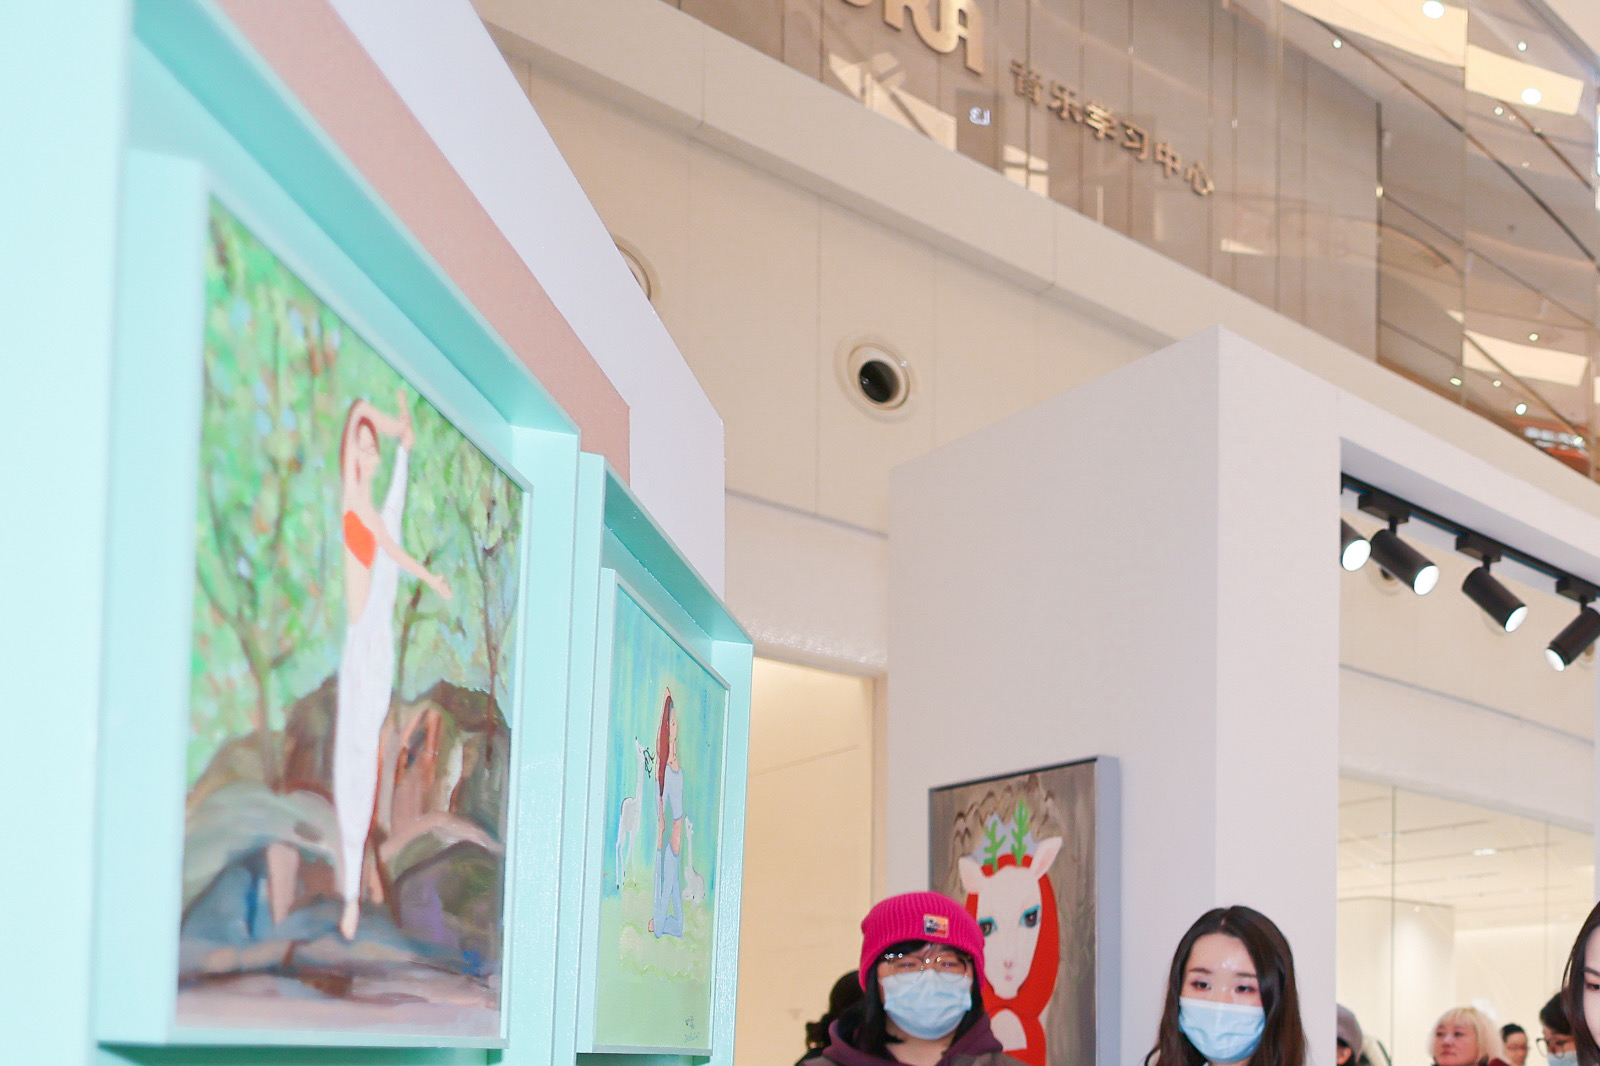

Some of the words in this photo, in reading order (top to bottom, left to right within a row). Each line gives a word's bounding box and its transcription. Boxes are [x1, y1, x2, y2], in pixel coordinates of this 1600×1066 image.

[1009, 58, 1216, 196] 音乐学习中心
